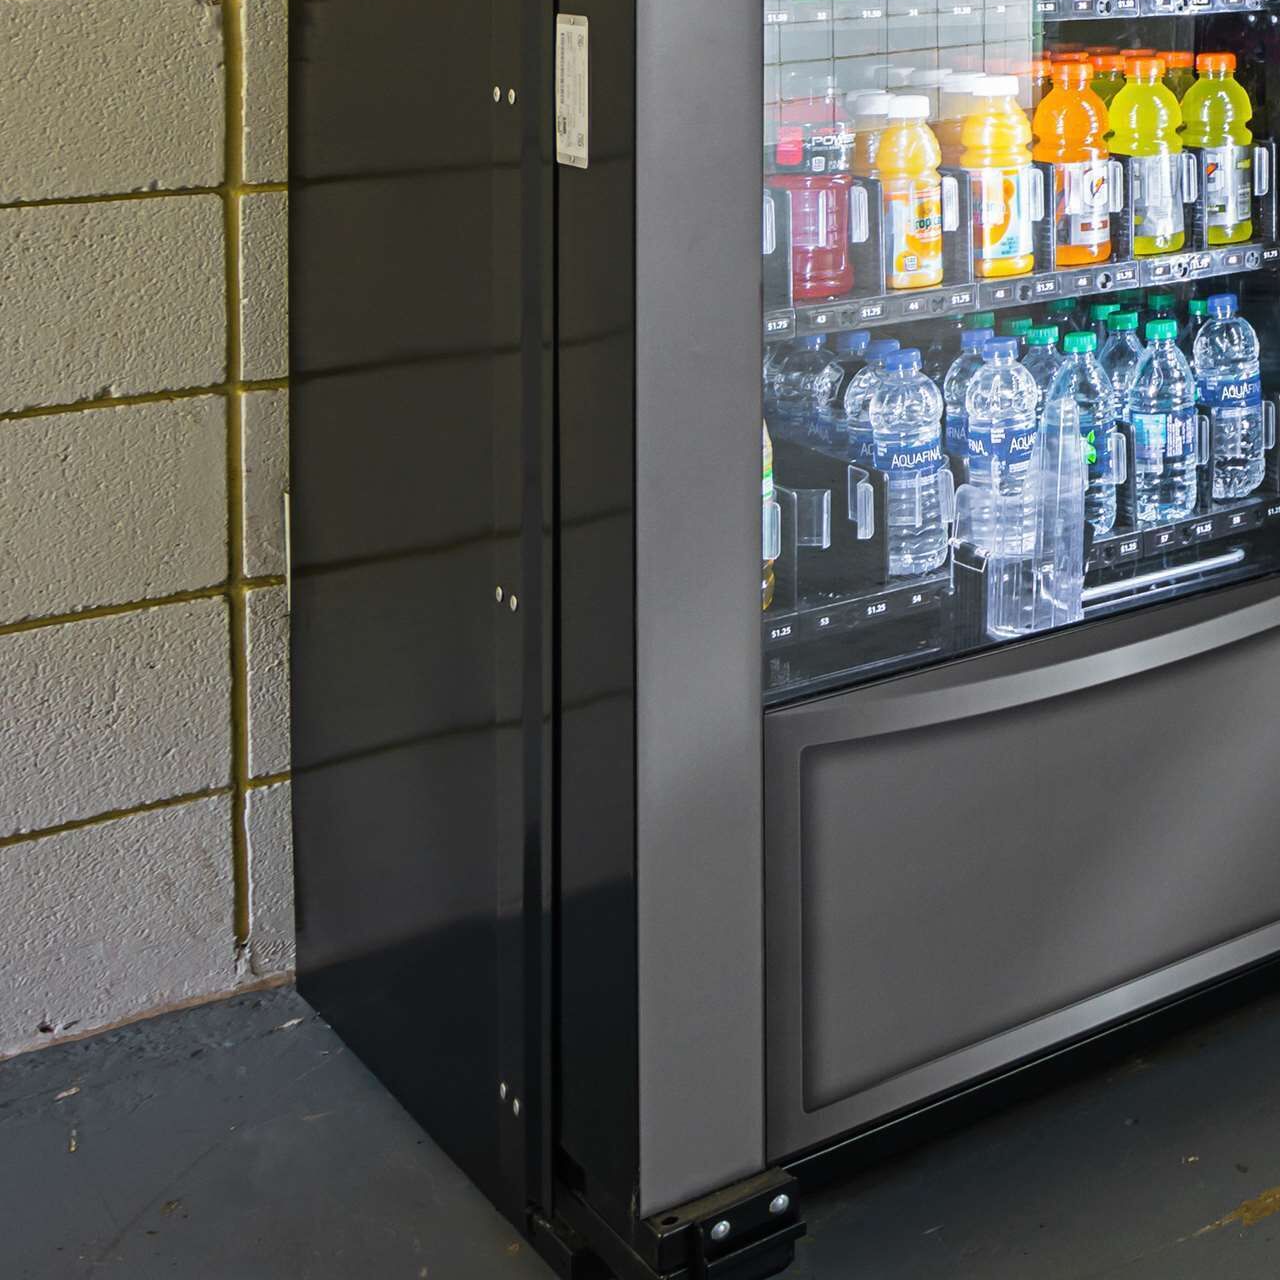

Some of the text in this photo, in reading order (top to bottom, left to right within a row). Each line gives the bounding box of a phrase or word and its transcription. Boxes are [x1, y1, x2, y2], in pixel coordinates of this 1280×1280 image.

[1221, 382, 1260, 401] AQUAFIN
[891, 446, 942, 469] AQUAFINA
[867, 603, 886, 615] $1.25
[771, 626, 791, 638] $1.25
